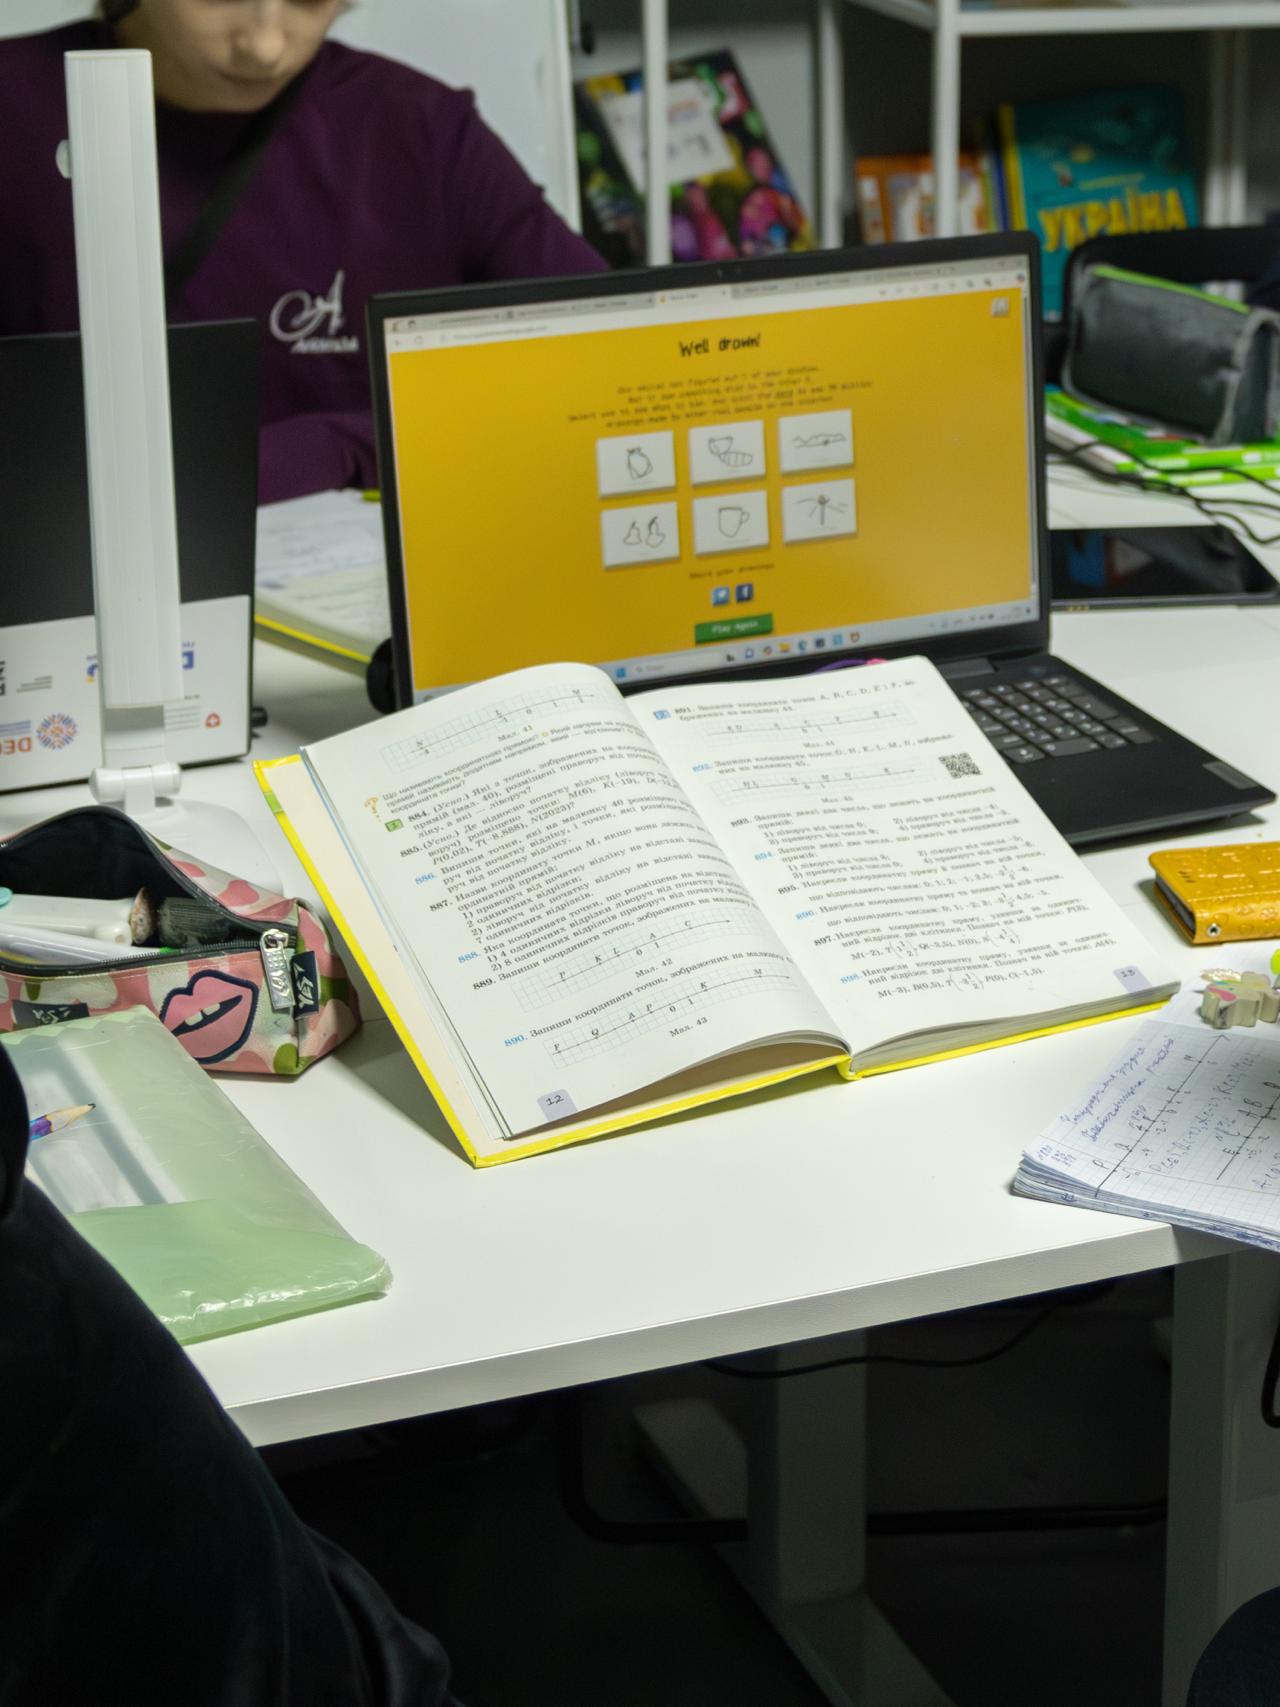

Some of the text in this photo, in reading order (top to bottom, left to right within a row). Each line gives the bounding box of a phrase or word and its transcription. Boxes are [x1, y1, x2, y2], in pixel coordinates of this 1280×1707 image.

[1039, 187, 1187, 251] УКРАЇНА
[680, 338, 710, 357] Well
[399, 844, 423, 857] 885.
[429, 898, 453, 912] 887.
[457, 950, 480, 963] 888.
[472, 977, 496, 990] 889.
[497, 959, 540, 981] Запиши
[503, 1033, 528, 1047] 890.
[529, 1017, 572, 1038] Запиши
[574, 990, 633, 1022] координати
[546, 1095, 564, 1106] 12
